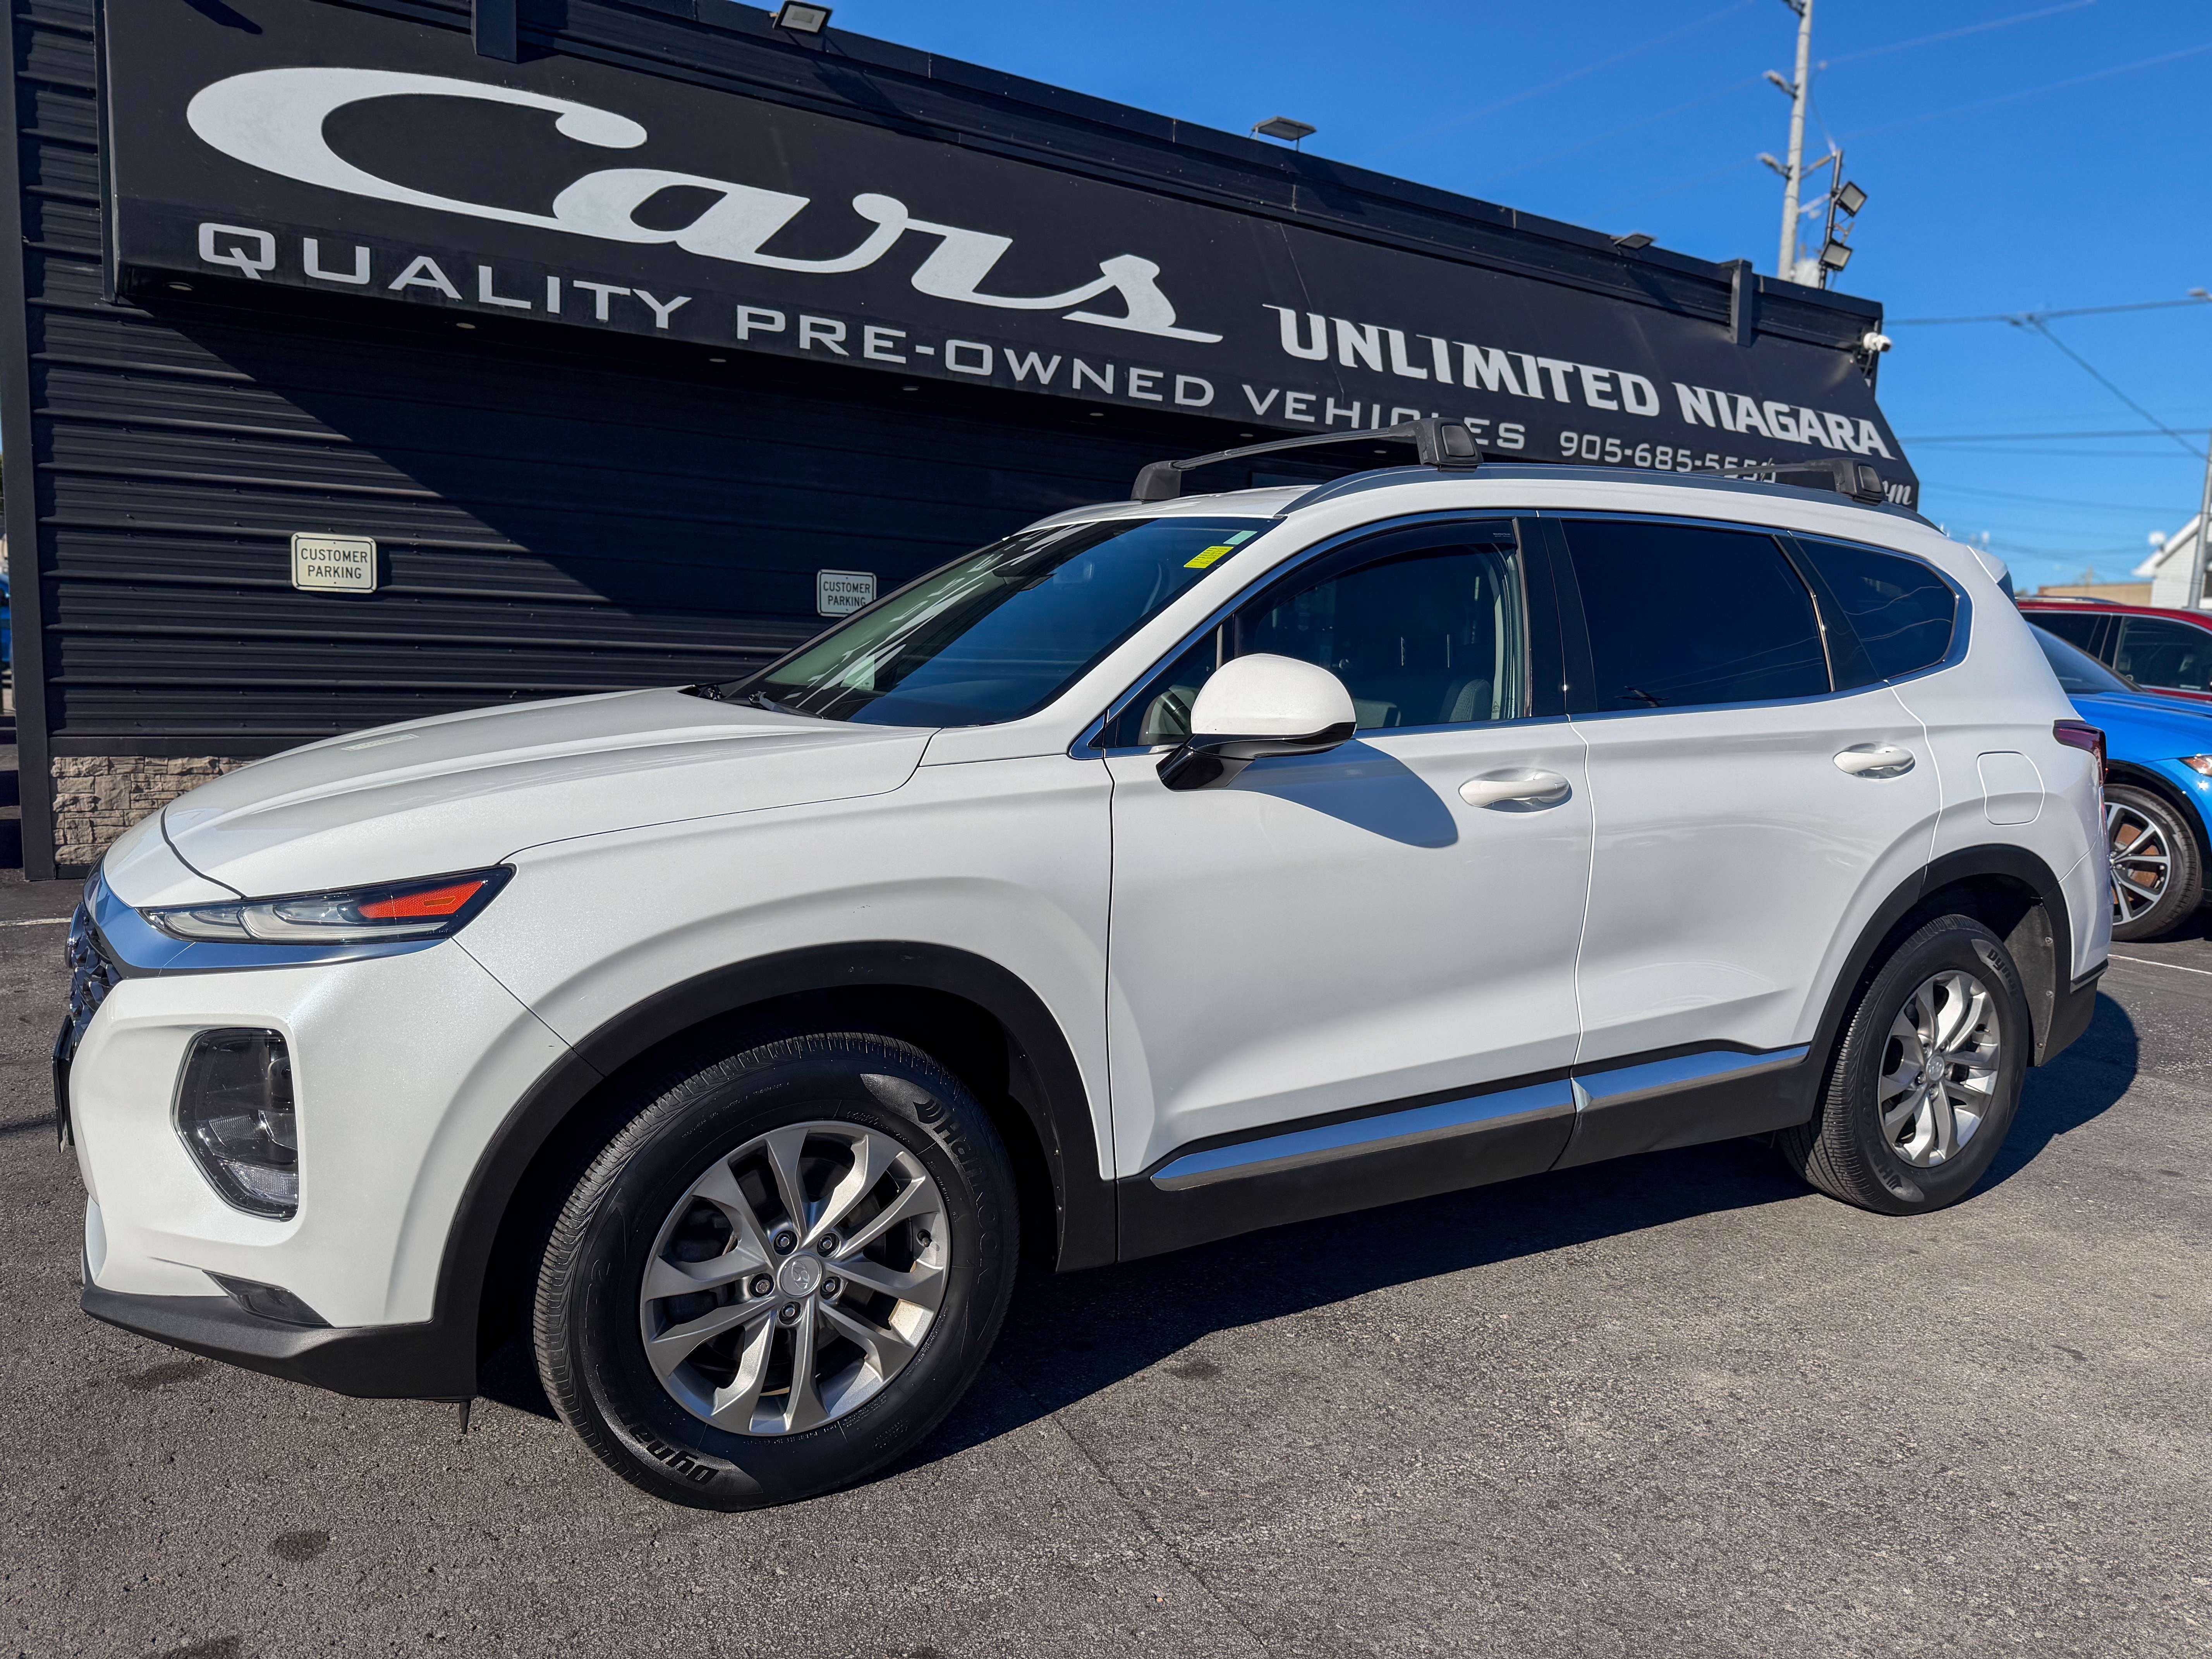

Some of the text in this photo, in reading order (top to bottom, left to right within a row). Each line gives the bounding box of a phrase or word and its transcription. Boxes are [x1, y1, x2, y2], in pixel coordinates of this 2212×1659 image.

[187, 68, 1223, 343] Cars
[198, 222, 1525, 450] QUALITY PRE-OWNED VEHICES
[1262, 304, 1897, 460] UNLIMITED NIAGARA
[301, 548, 368, 563] CUSTOMER
[308, 565, 361, 579] PARKING
[823, 581, 871, 594] CUSTOMER
[828, 595, 866, 607] PARKING
